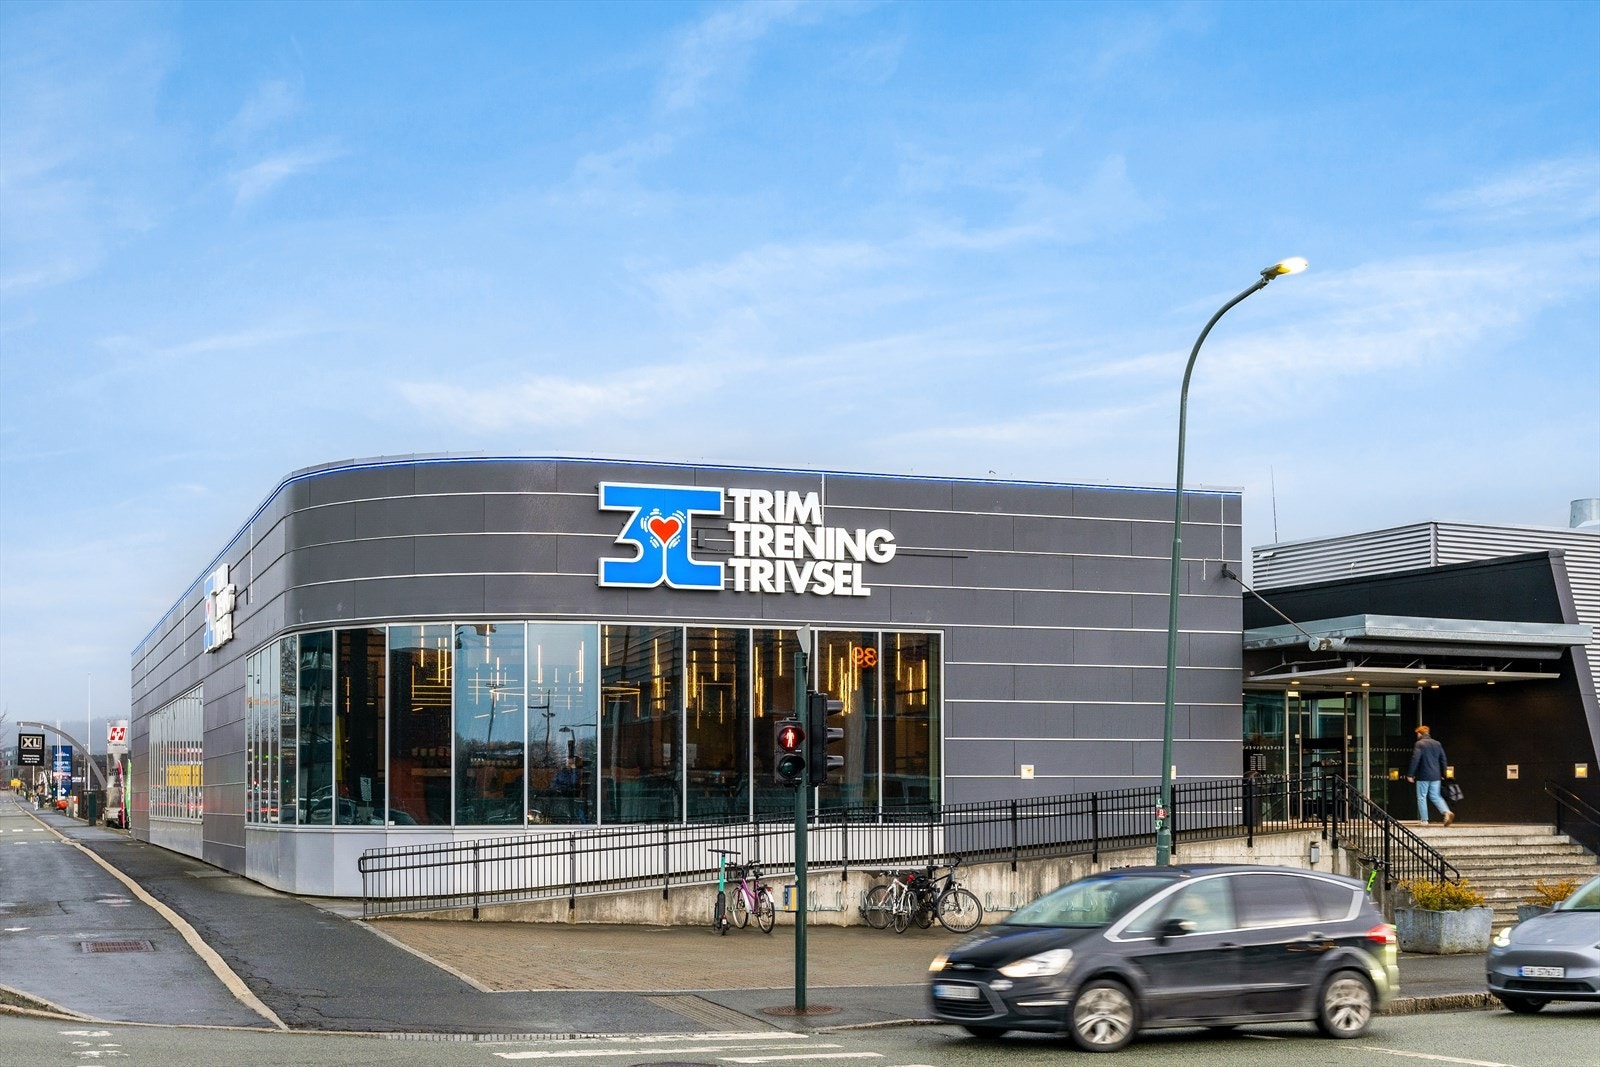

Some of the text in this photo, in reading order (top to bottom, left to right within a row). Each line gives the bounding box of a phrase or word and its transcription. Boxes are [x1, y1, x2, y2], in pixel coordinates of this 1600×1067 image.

[728, 488, 822, 525] TRIM
[728, 522, 897, 564] TRENING
[728, 558, 871, 596] TRIVSEL
